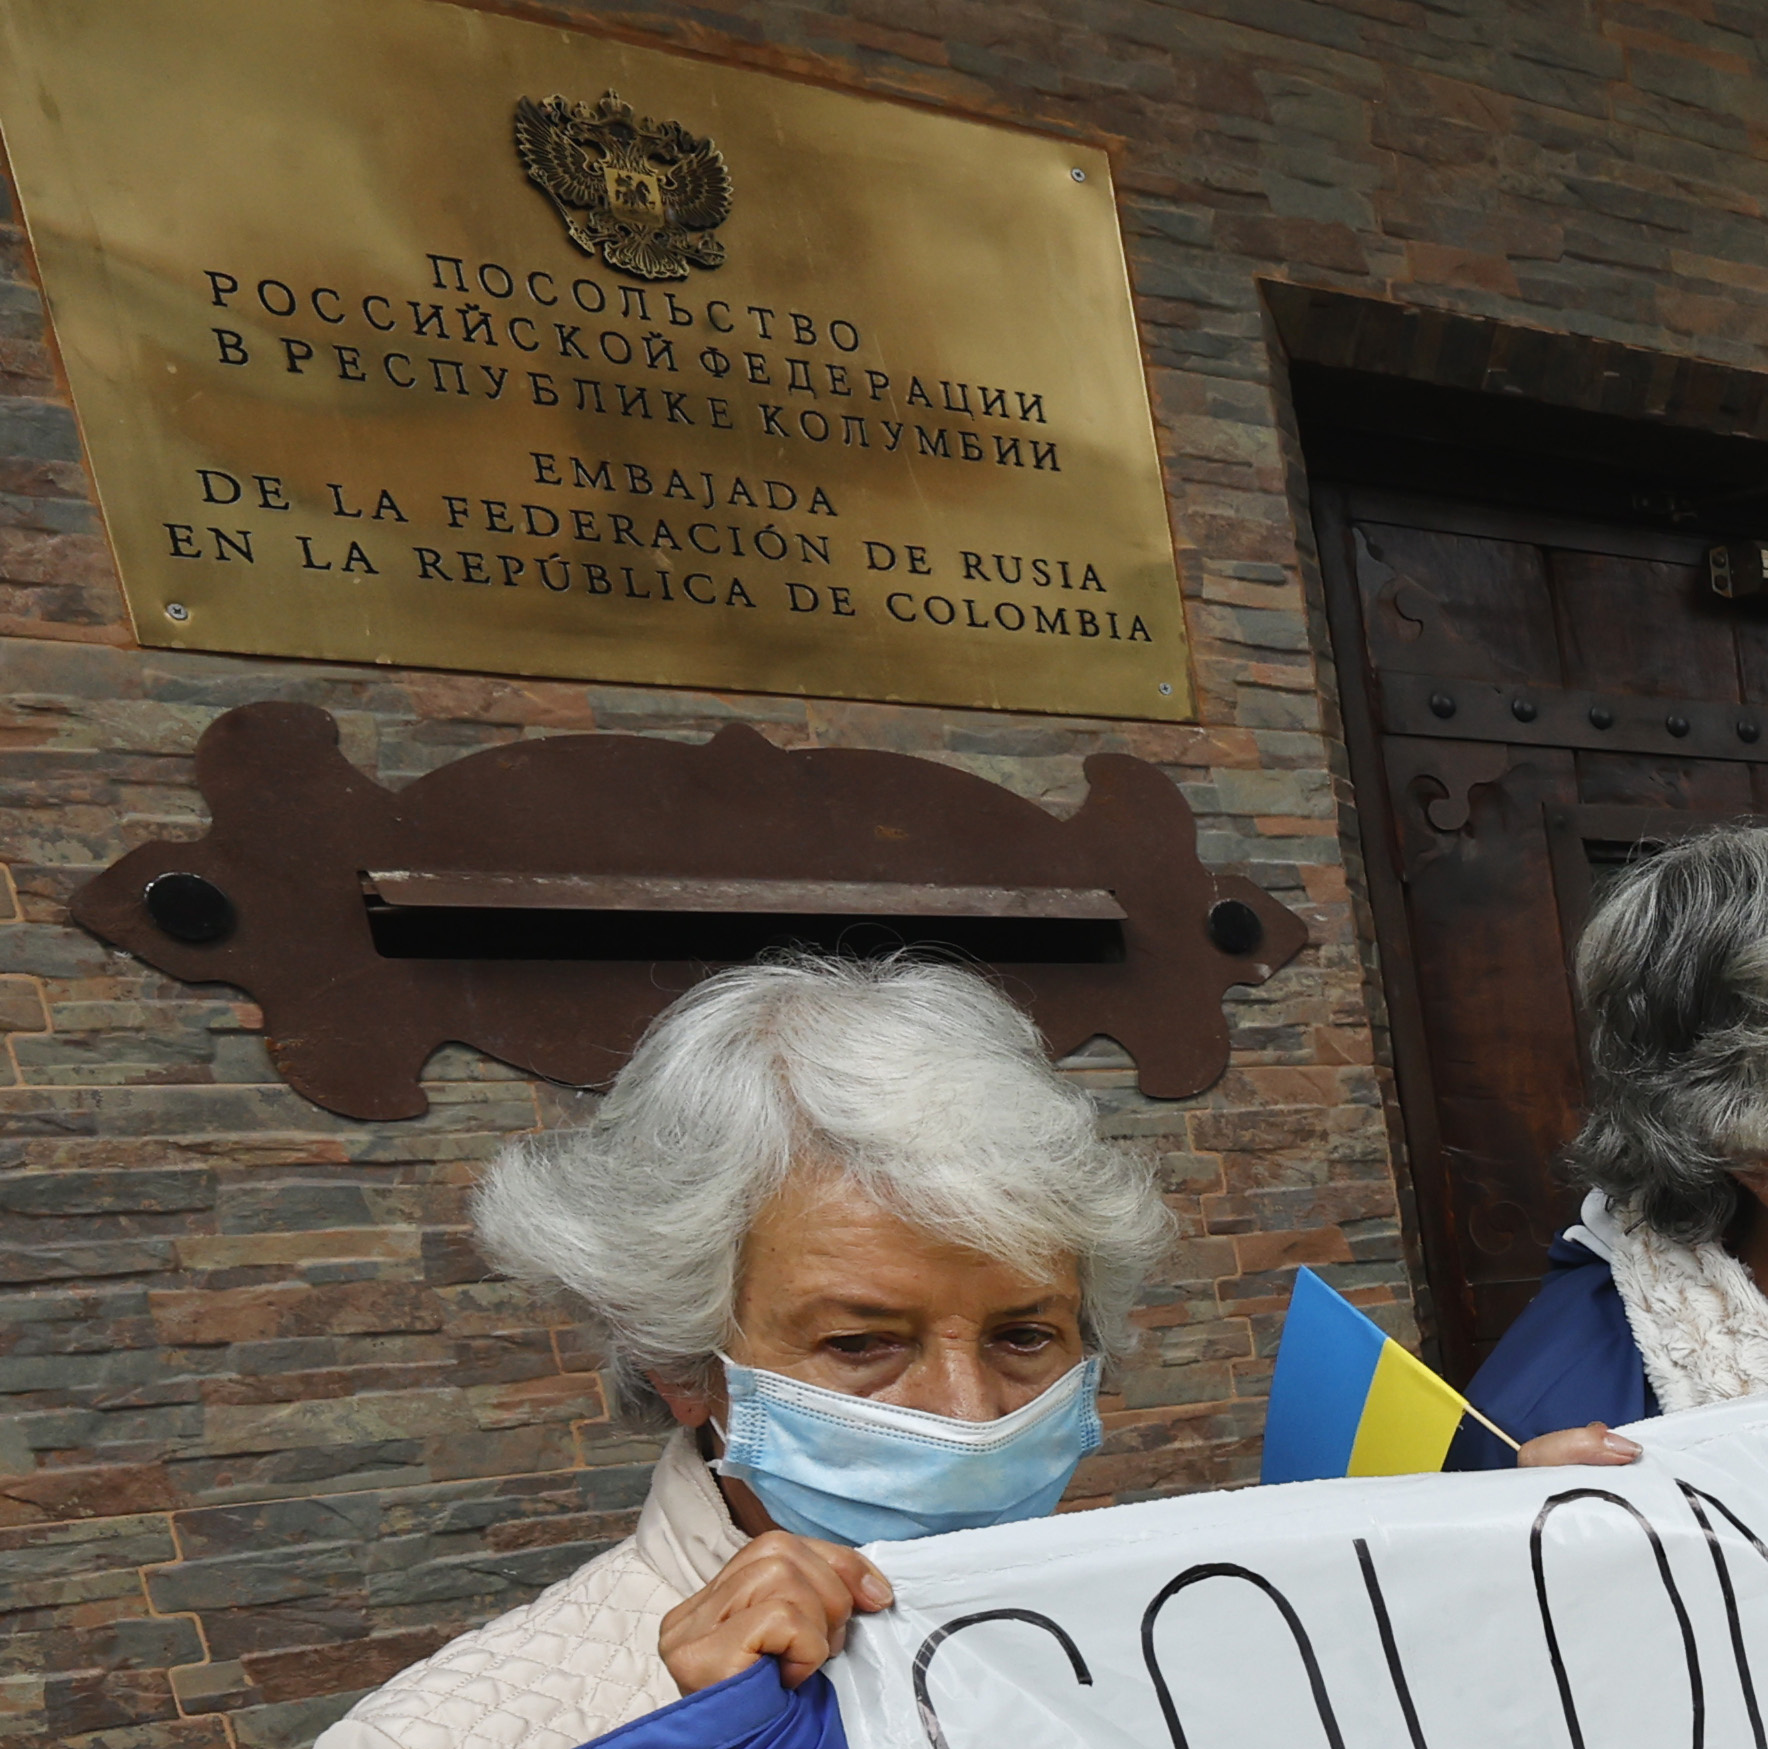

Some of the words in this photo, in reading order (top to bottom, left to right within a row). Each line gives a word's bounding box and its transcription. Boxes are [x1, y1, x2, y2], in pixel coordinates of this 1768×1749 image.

[203, 270, 677, 372] РОССИЙСКОЙ
[698, 346, 1048, 425] ФЕДЕРАЦИИ
[425, 253, 861, 353] ПОСОЛЬСТВО
[213, 328, 250, 367] В
[285, 338, 735, 430] РЕСПУБЛИКЕ
[760, 404, 1062, 473] КОЛУМБИИ
[197, 468, 292, 513] DE
[331, 481, 410, 524] LA
[443, 495, 832, 567] FEDERACIÓN
[864, 538, 934, 577] DE
[960, 549, 1108, 594] RUSIA
[529, 451, 839, 518] EMBAJADA
[163, 522, 257, 564] EN
[295, 534, 382, 576] LA
[413, 545, 758, 608] REPÚBLICA
[788, 581, 858, 620] DE
[884, 591, 1154, 644] COLOMBIA
